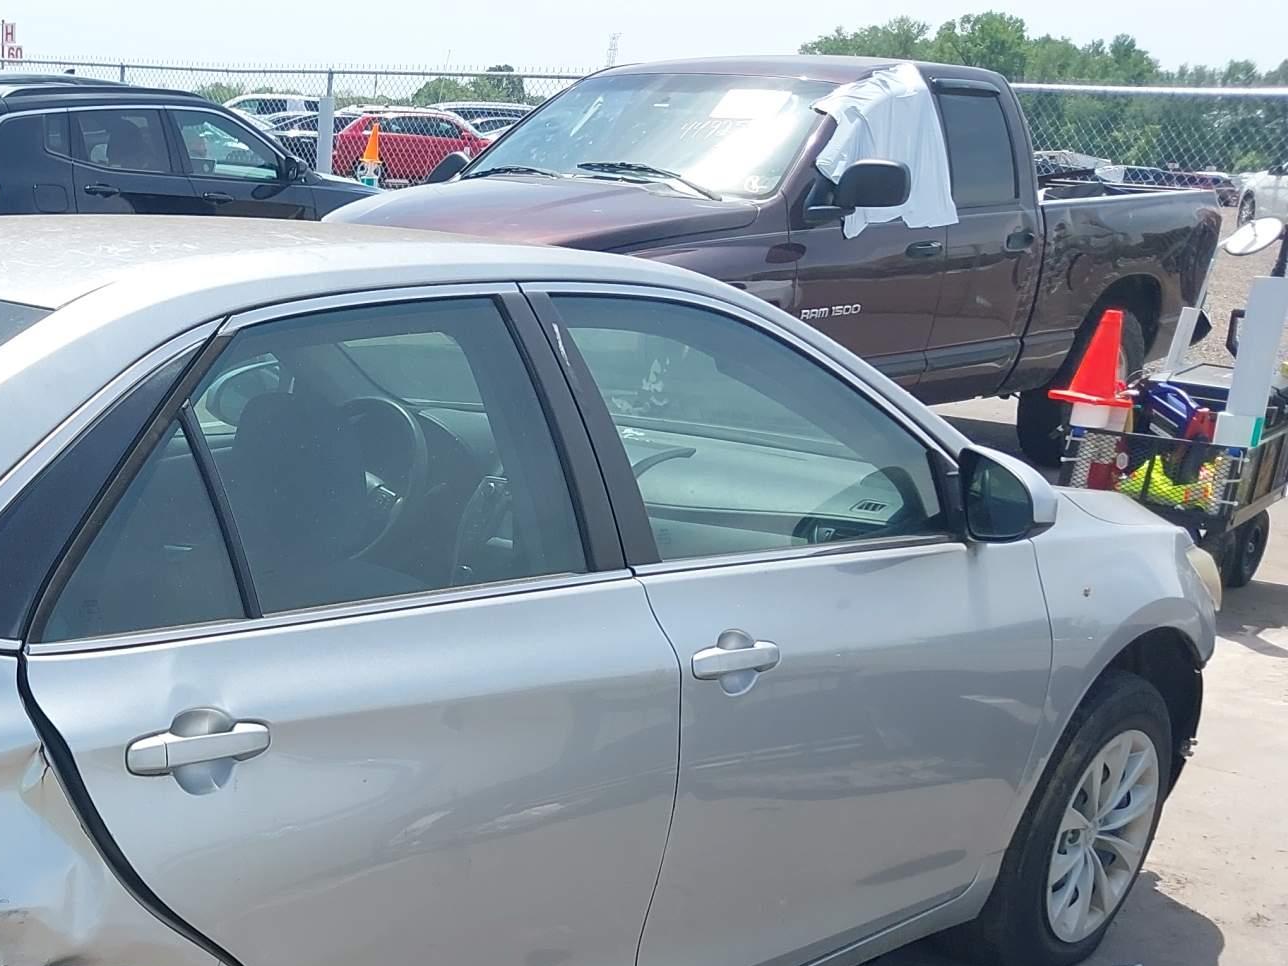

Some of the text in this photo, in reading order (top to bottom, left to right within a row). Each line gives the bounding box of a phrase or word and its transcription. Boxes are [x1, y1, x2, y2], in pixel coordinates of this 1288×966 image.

[5, 24, 14, 42] H
[800, 303, 861, 320] RAM 1500
